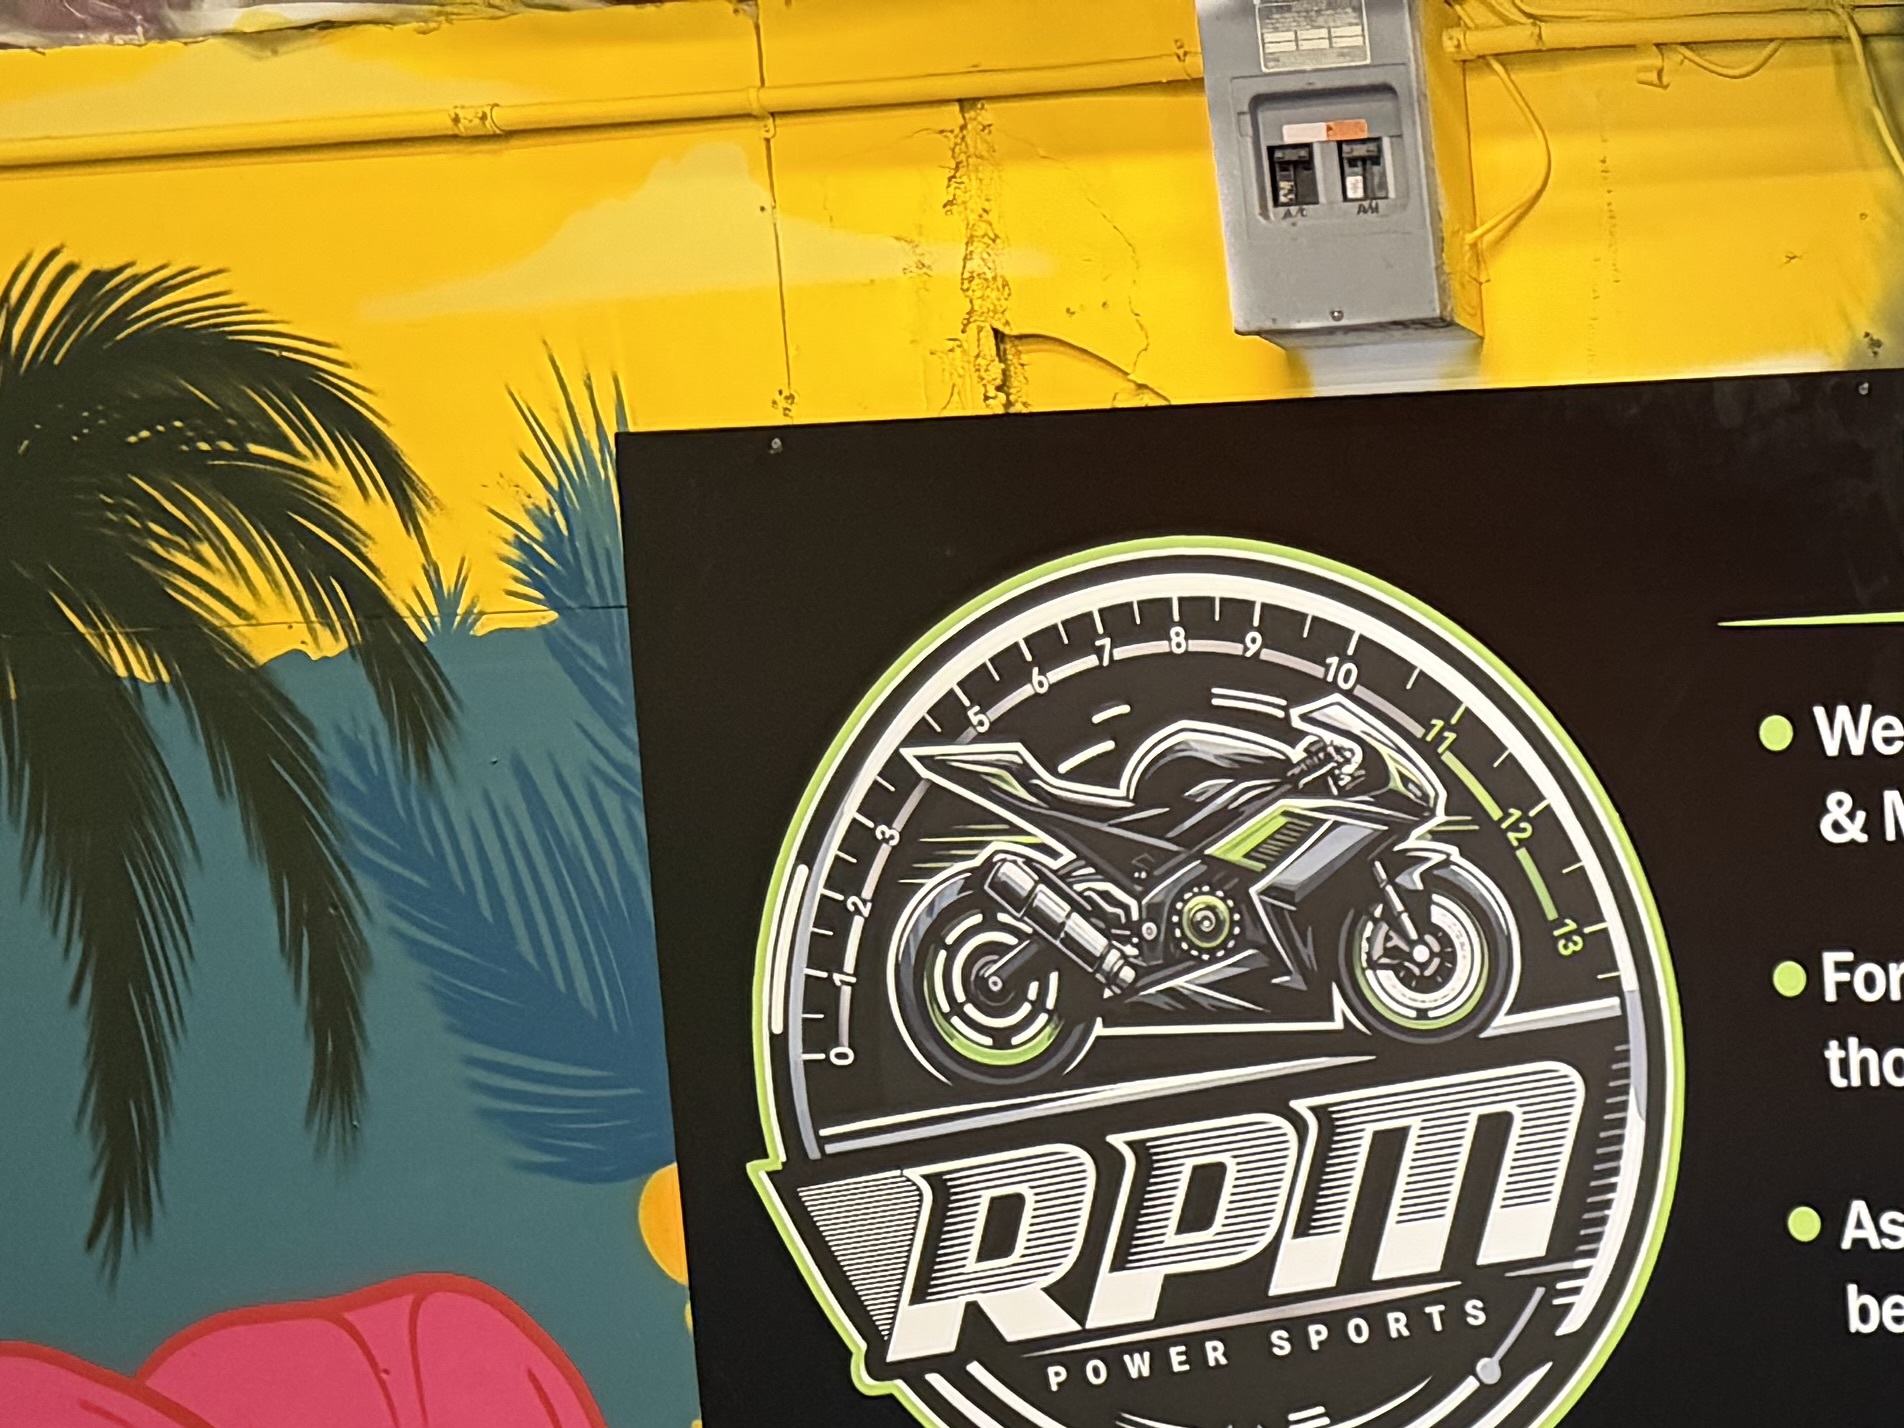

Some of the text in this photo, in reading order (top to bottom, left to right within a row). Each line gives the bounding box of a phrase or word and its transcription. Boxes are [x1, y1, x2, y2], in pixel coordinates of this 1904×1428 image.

[1813, 704, 1904, 756] We
[827, 1046, 856, 1065] 0
[846, 894, 873, 915] 2
[876, 825, 899, 845] 3
[966, 706, 990, 732] 5
[1031, 669, 1050, 694] 6
[1094, 637, 1115, 667] 7
[1168, 627, 1187, 655] 8
[1242, 631, 1263, 657] 9
[1325, 656, 1357, 690] 10
[1426, 719, 1458, 751] 11
[1500, 809, 1532, 845] 12
[1556, 918, 1583, 953] 13
[1820, 791, 1868, 843] &
[886, 1060, 1585, 1362] RPM
[1047, 1299, 1487, 1390] POWER SPORTS
